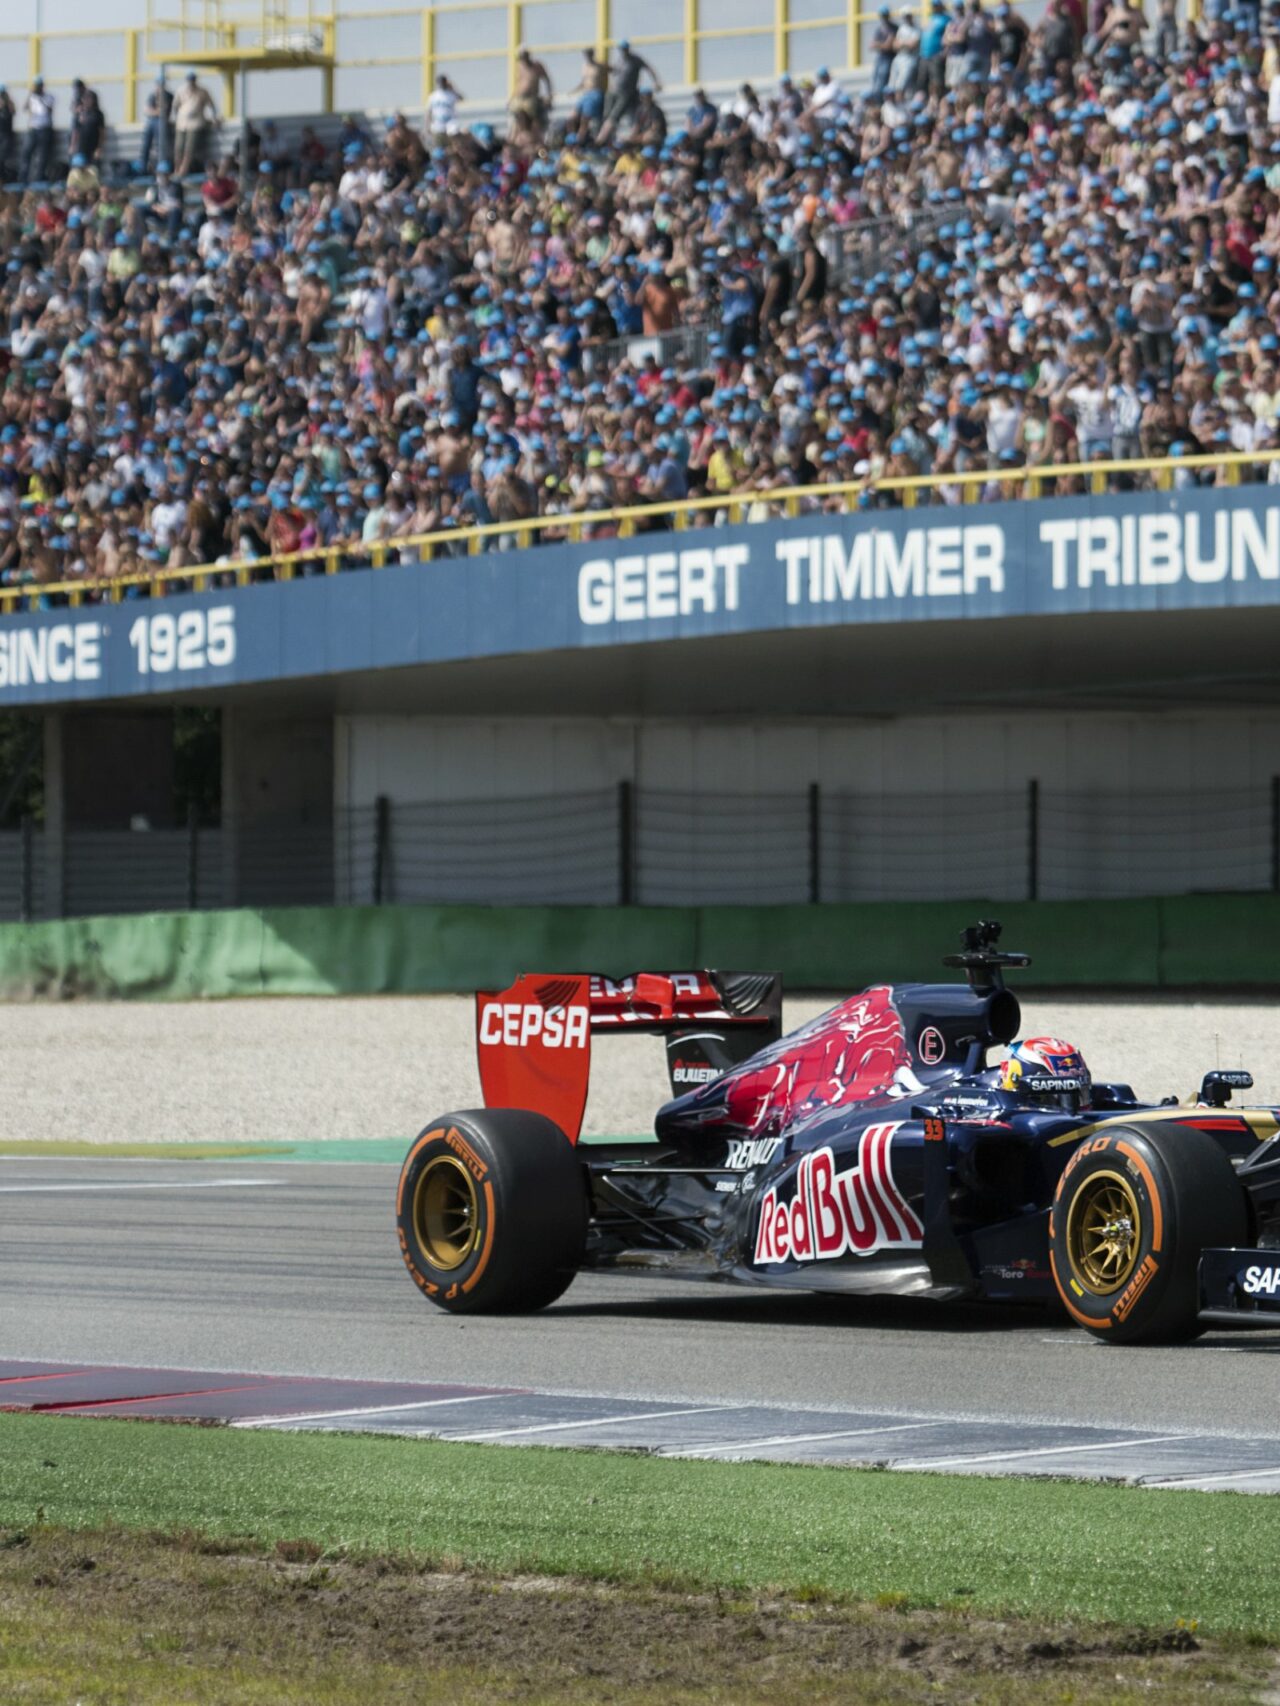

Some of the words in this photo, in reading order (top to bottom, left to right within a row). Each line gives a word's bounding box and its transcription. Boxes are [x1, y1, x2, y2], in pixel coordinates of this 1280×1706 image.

[577, 544, 750, 626] GEERT
[776, 524, 1003, 604] TIMMER
[128, 605, 237, 675] 1925
[479, 1003, 589, 1048] CEPSA
[1031, 1079, 1081, 1091] SAPINDA
[445, 1126, 489, 1183] PIRELLI
[924, 1119, 944, 1141] 33
[754, 1153, 814, 1264] Red
[811, 1121, 925, 1257] Bull
[1111, 1254, 1160, 1323] PIRELLI
